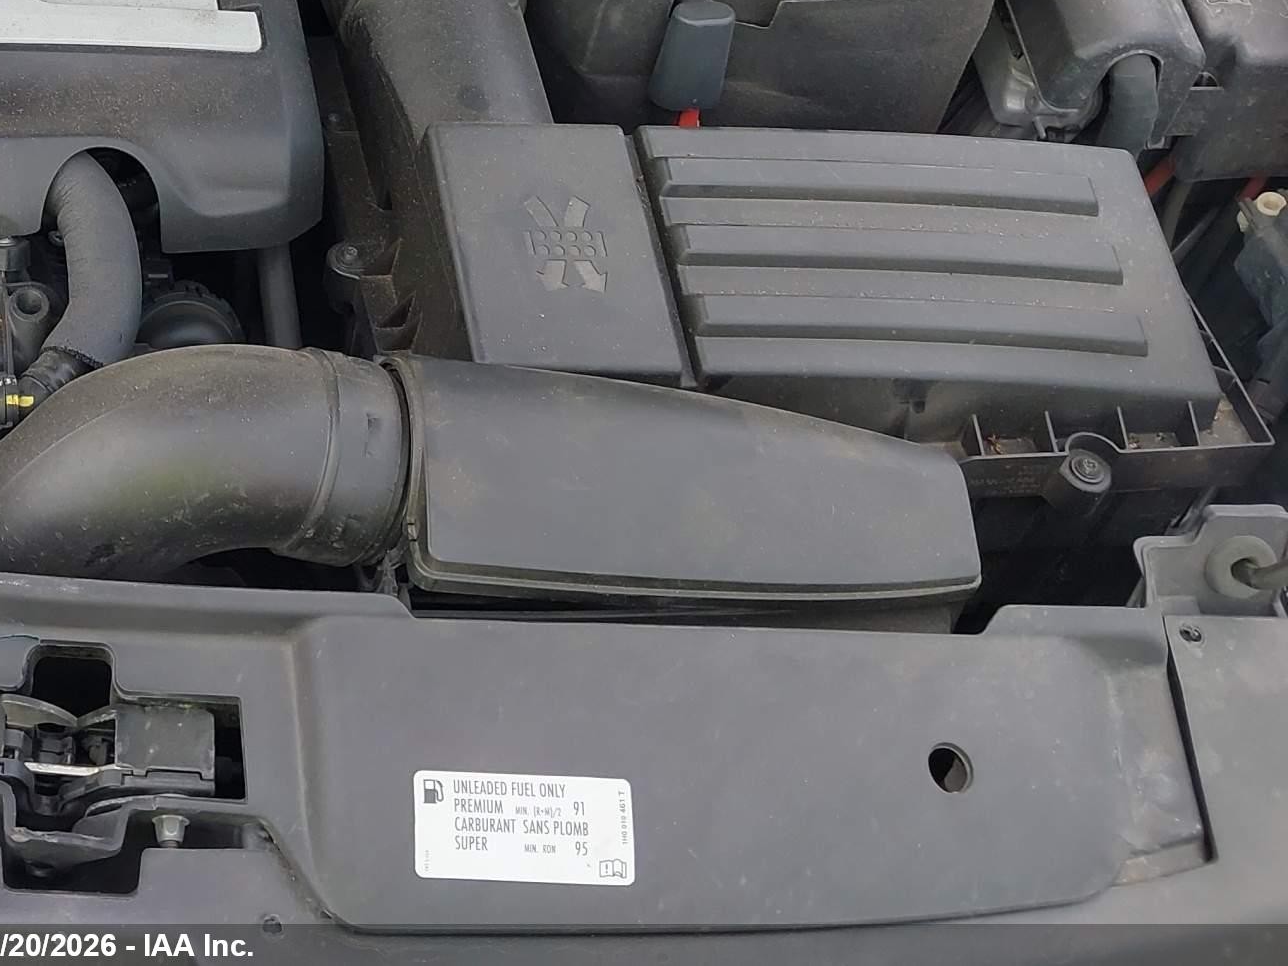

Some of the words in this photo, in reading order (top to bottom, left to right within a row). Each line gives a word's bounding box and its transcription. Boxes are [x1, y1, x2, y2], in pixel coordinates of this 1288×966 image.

[453, 779, 507, 796] UNLEADED
[512, 782, 536, 798] FUEL
[539, 783, 565, 798] ONLY
[454, 798, 503, 815] PREMIUM
[515, 806, 530, 816] MIN.
[573, 801, 585, 817] 91
[454, 816, 516, 835] CARBURANT
[523, 819, 550, 835] SANS
[553, 821, 589, 837] PLOMB
[455, 835, 488, 852] SUPER
[524, 844, 539, 854] MIN.
[542, 844, 556, 854] RON
[575, 841, 588, 856] 95
